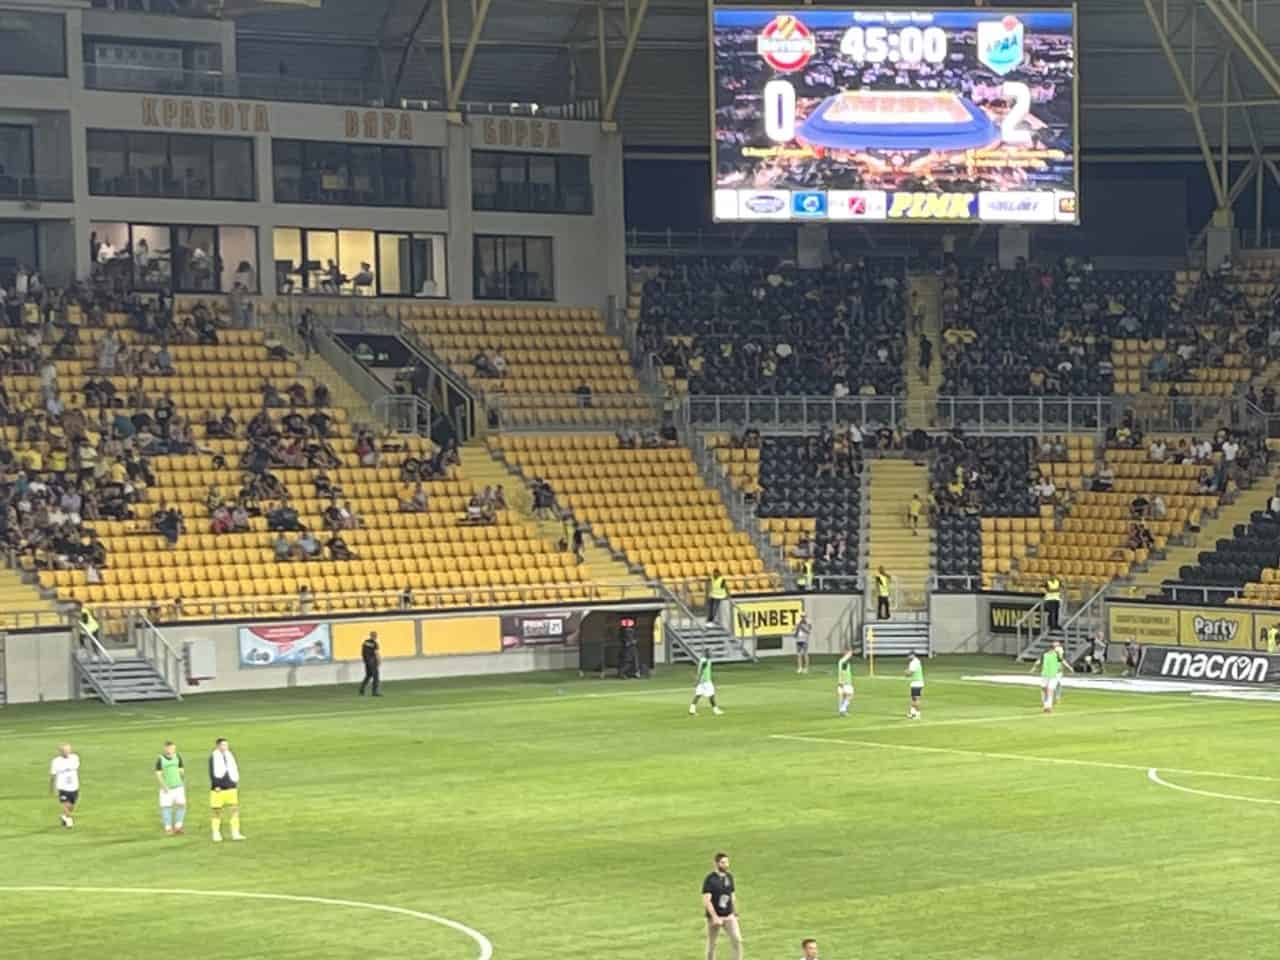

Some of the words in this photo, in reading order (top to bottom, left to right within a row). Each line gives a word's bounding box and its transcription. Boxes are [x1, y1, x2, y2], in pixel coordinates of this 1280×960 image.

[840, 27, 946, 63] 45:00
[142, 97, 271, 132] КРАСОТА
[344, 109, 414, 140] ВЯРА
[764, 80, 796, 142] 0
[1000, 82, 1032, 145] 2
[482, 117, 561, 147] БОРБА
[737, 607, 798, 629] WINBET
[1193, 616, 1238, 640] Party
[1162, 651, 1269, 682] macron
